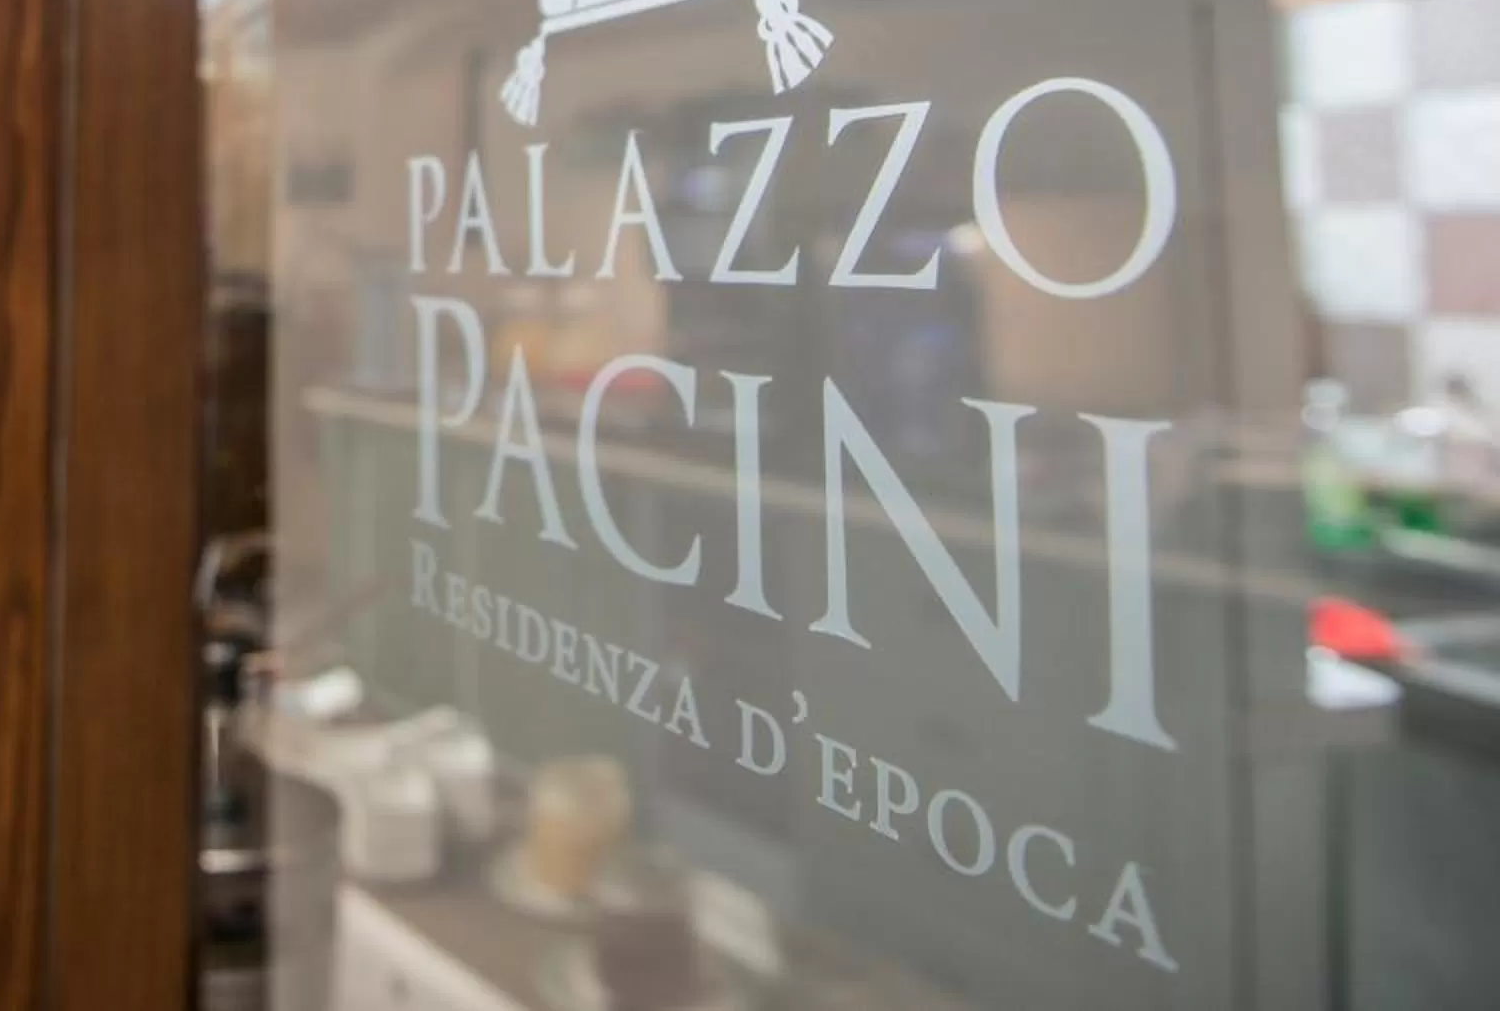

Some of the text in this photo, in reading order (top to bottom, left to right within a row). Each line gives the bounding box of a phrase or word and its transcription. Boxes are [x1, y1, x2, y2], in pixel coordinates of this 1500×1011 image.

[407, 76, 1177, 298] PALAZZO
[411, 295, 1179, 752] PACINI
[410, 539, 1180, 973] RESIDENZA D’EPOCA
